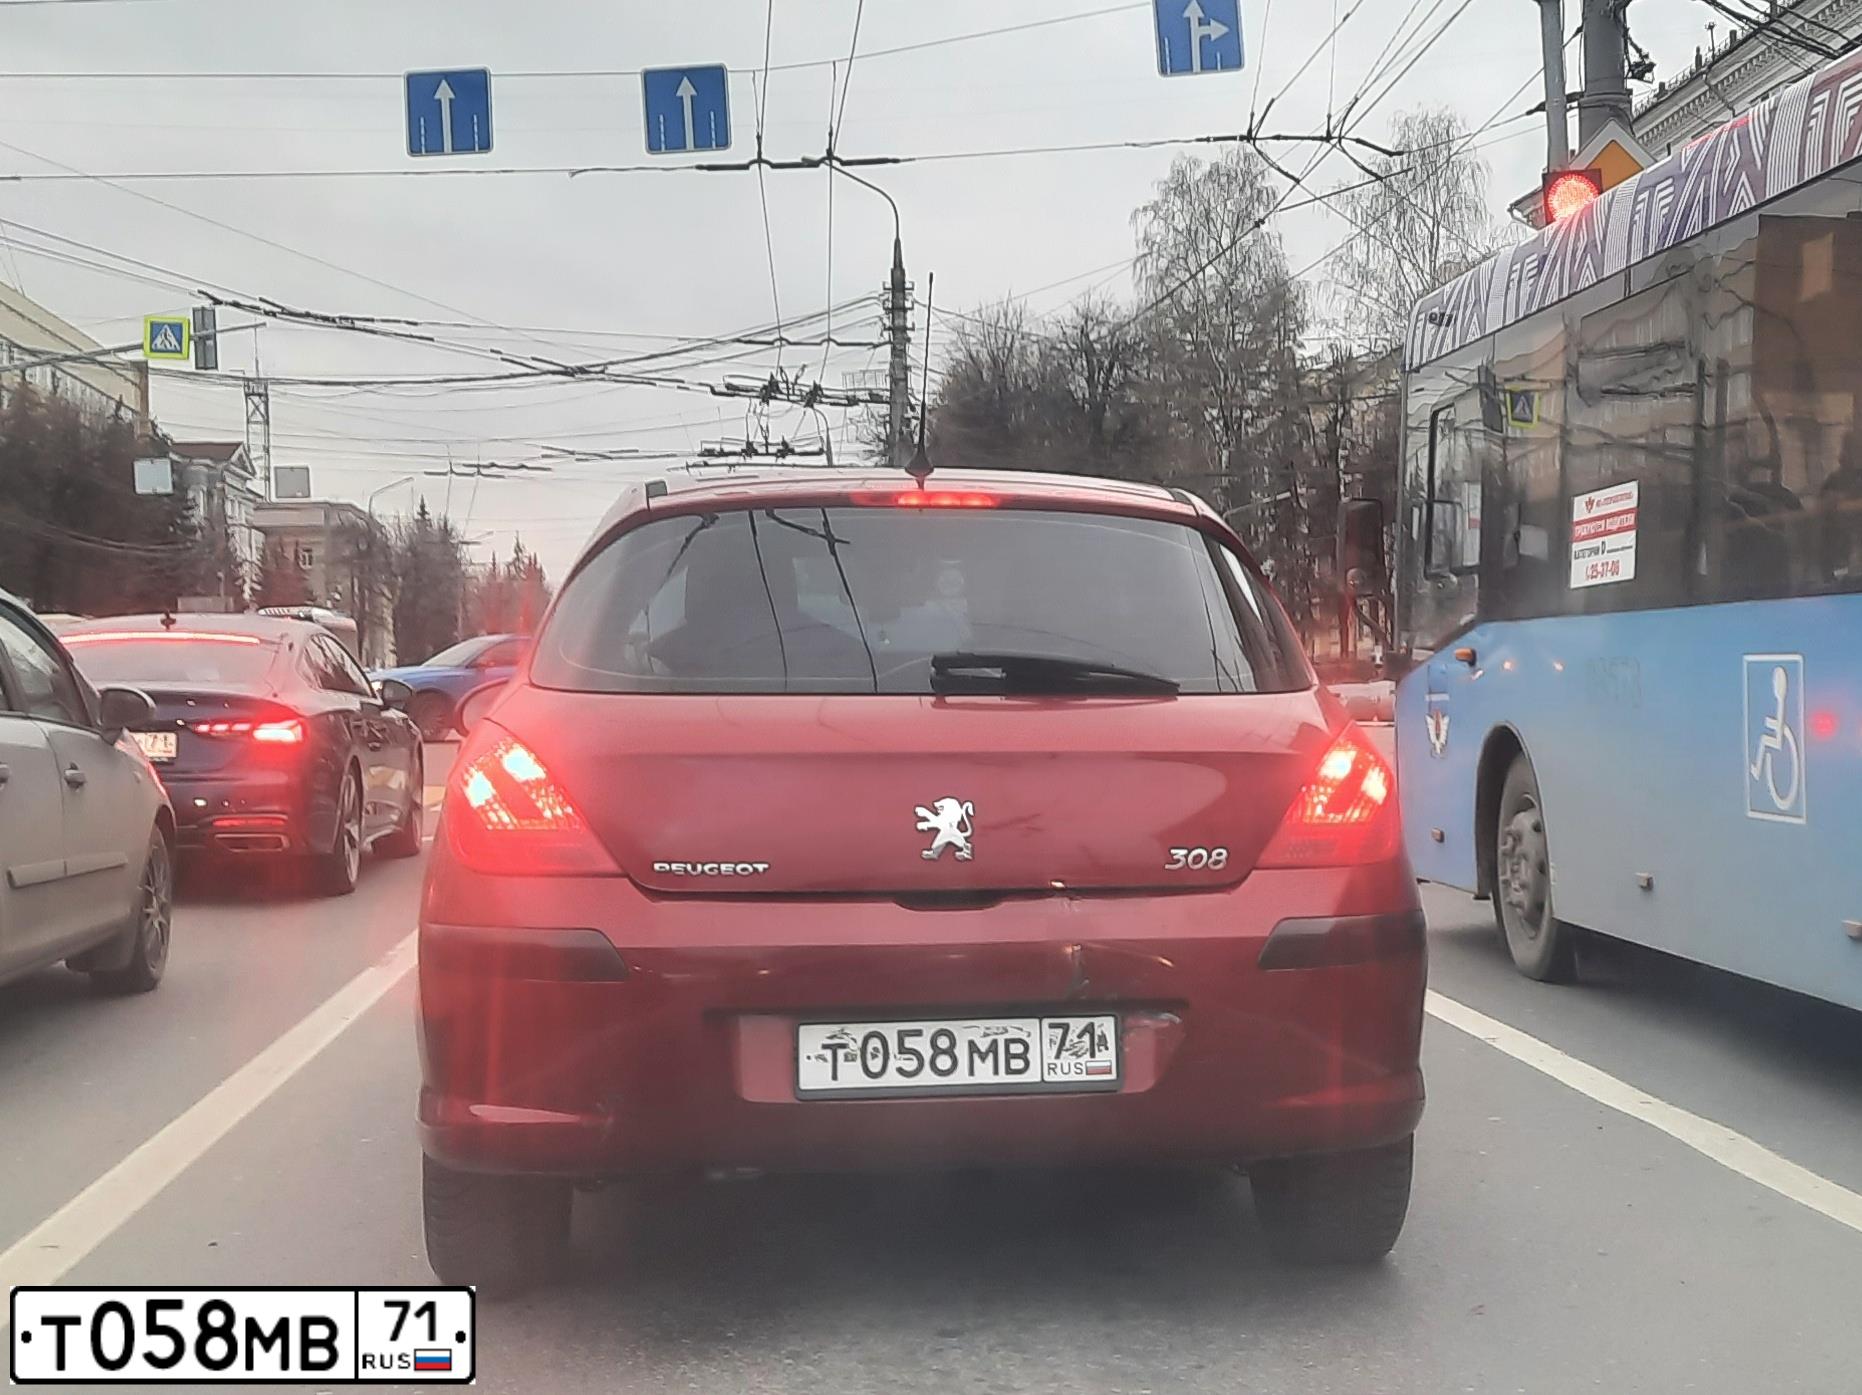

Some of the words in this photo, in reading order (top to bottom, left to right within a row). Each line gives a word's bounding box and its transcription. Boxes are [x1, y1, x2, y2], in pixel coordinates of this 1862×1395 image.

[1164, 847, 1229, 870] 308
[653, 862, 770, 876] PEUGEOT
[1048, 1021, 1097, 1060] 71
[1047, 1061, 1084, 1077] RUS
